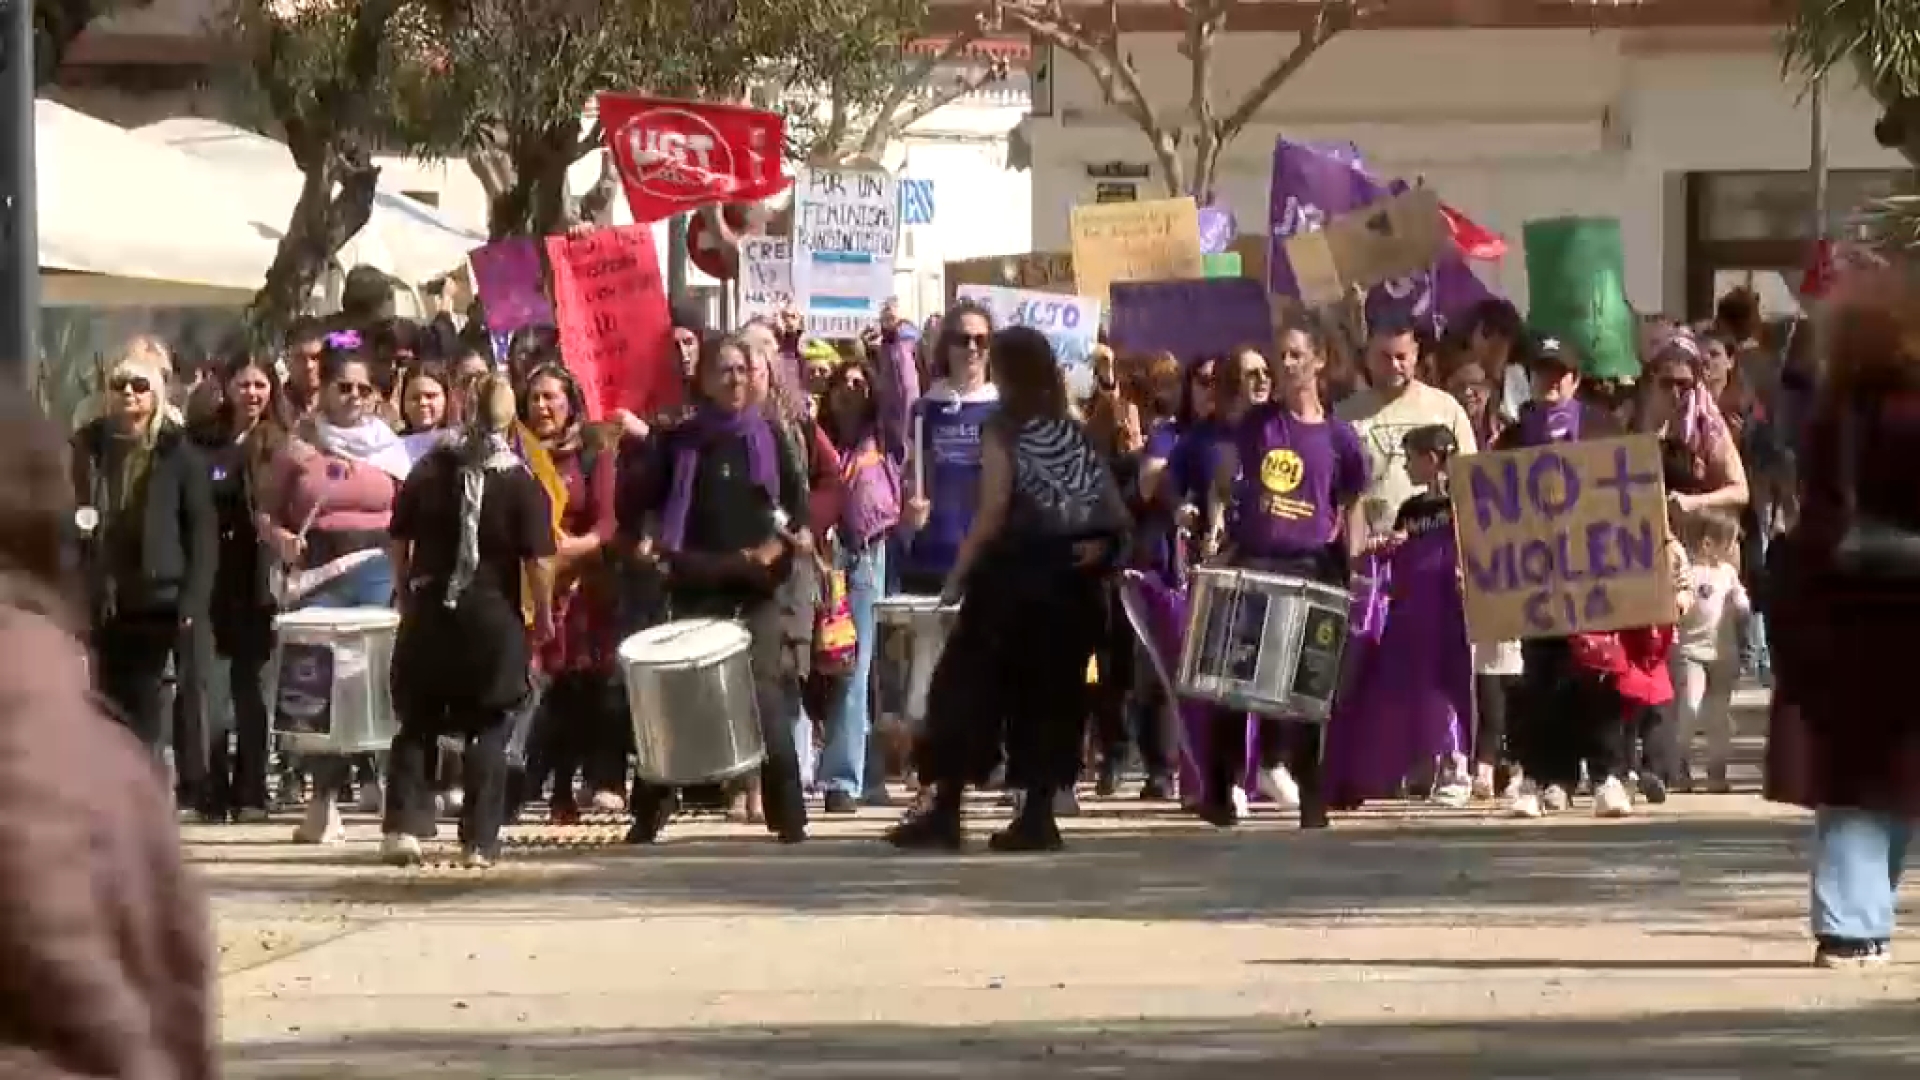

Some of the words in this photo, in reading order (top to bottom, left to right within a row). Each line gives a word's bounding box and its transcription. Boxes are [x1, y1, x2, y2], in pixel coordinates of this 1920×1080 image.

[630, 129, 714, 170] UGT
[809, 166, 846, 195] POR
[858, 174, 882, 197] UN
[1265, 456, 1299, 485] NO!
[1470, 451, 1580, 531] NO
[1468, 518, 1654, 593] VIOLEN
[1524, 583, 1613, 631] CIA
